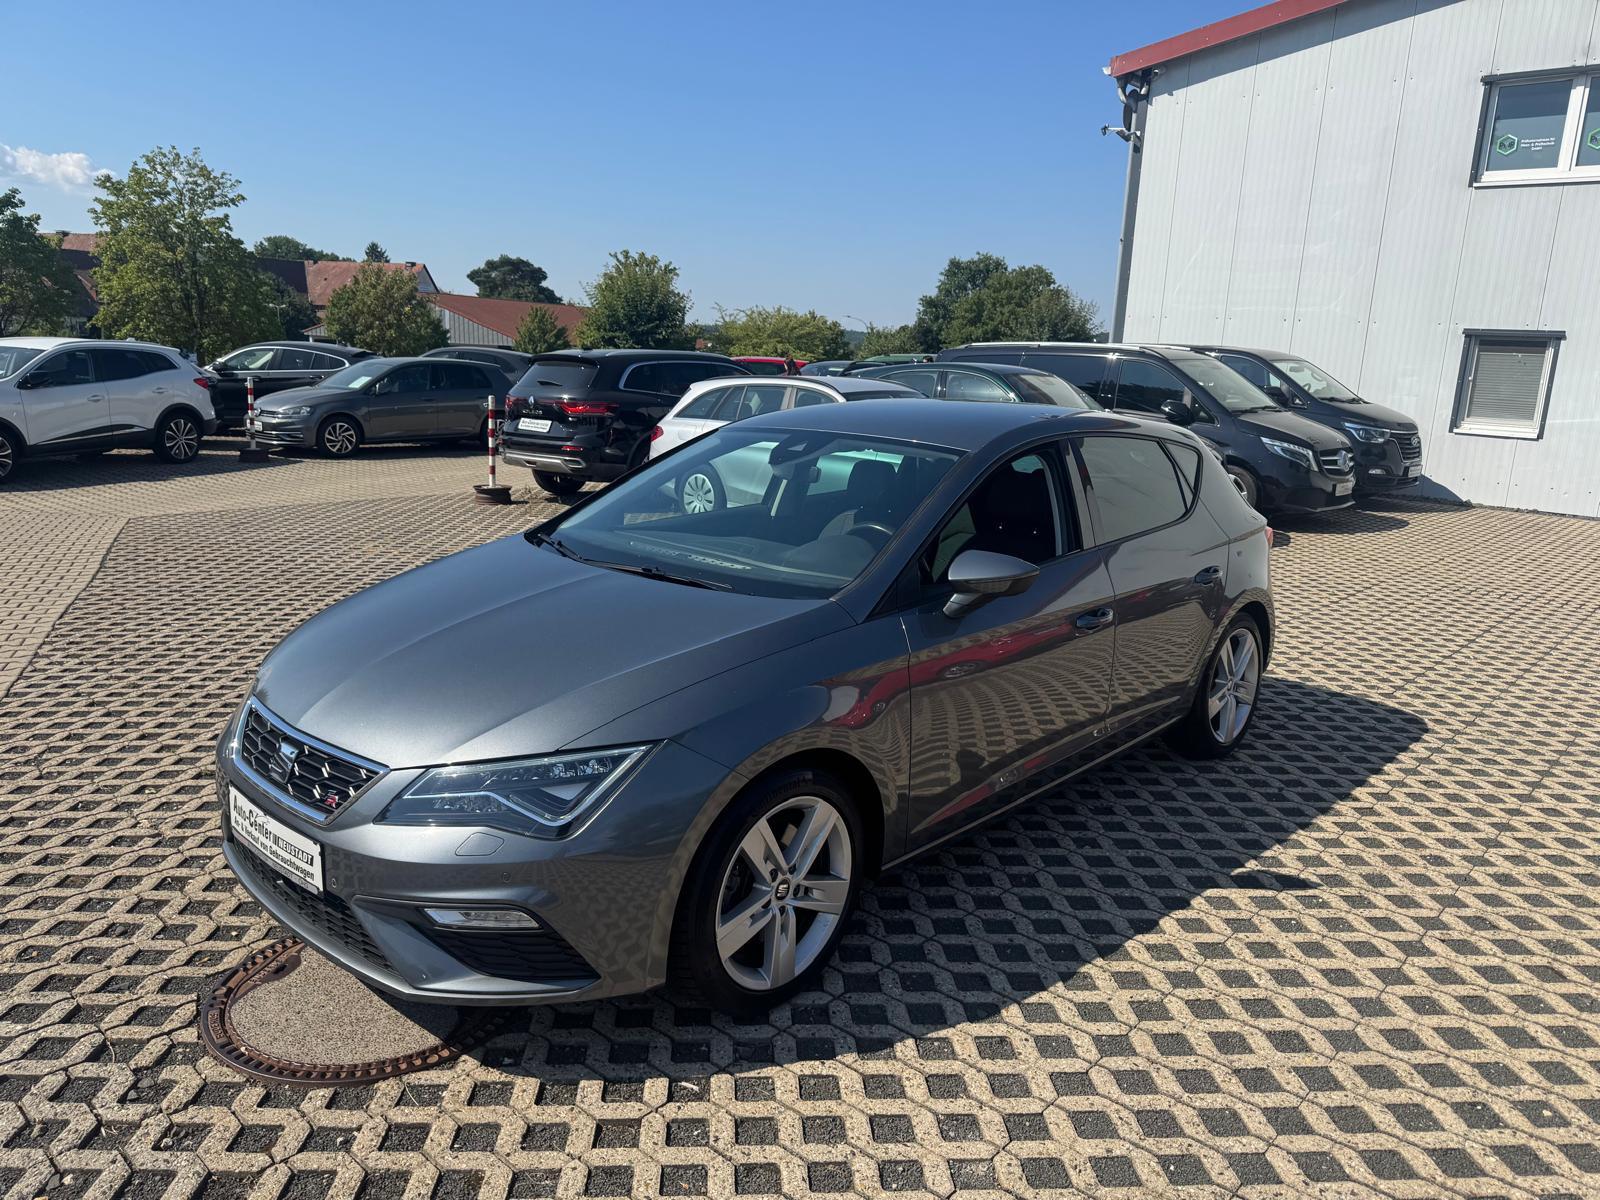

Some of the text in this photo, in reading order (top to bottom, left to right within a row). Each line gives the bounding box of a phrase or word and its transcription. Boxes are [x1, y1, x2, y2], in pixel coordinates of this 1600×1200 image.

[233, 795, 313, 866] Auto-Center NEUSTADT
[269, 845, 315, 882] Gebrauchtwagen
